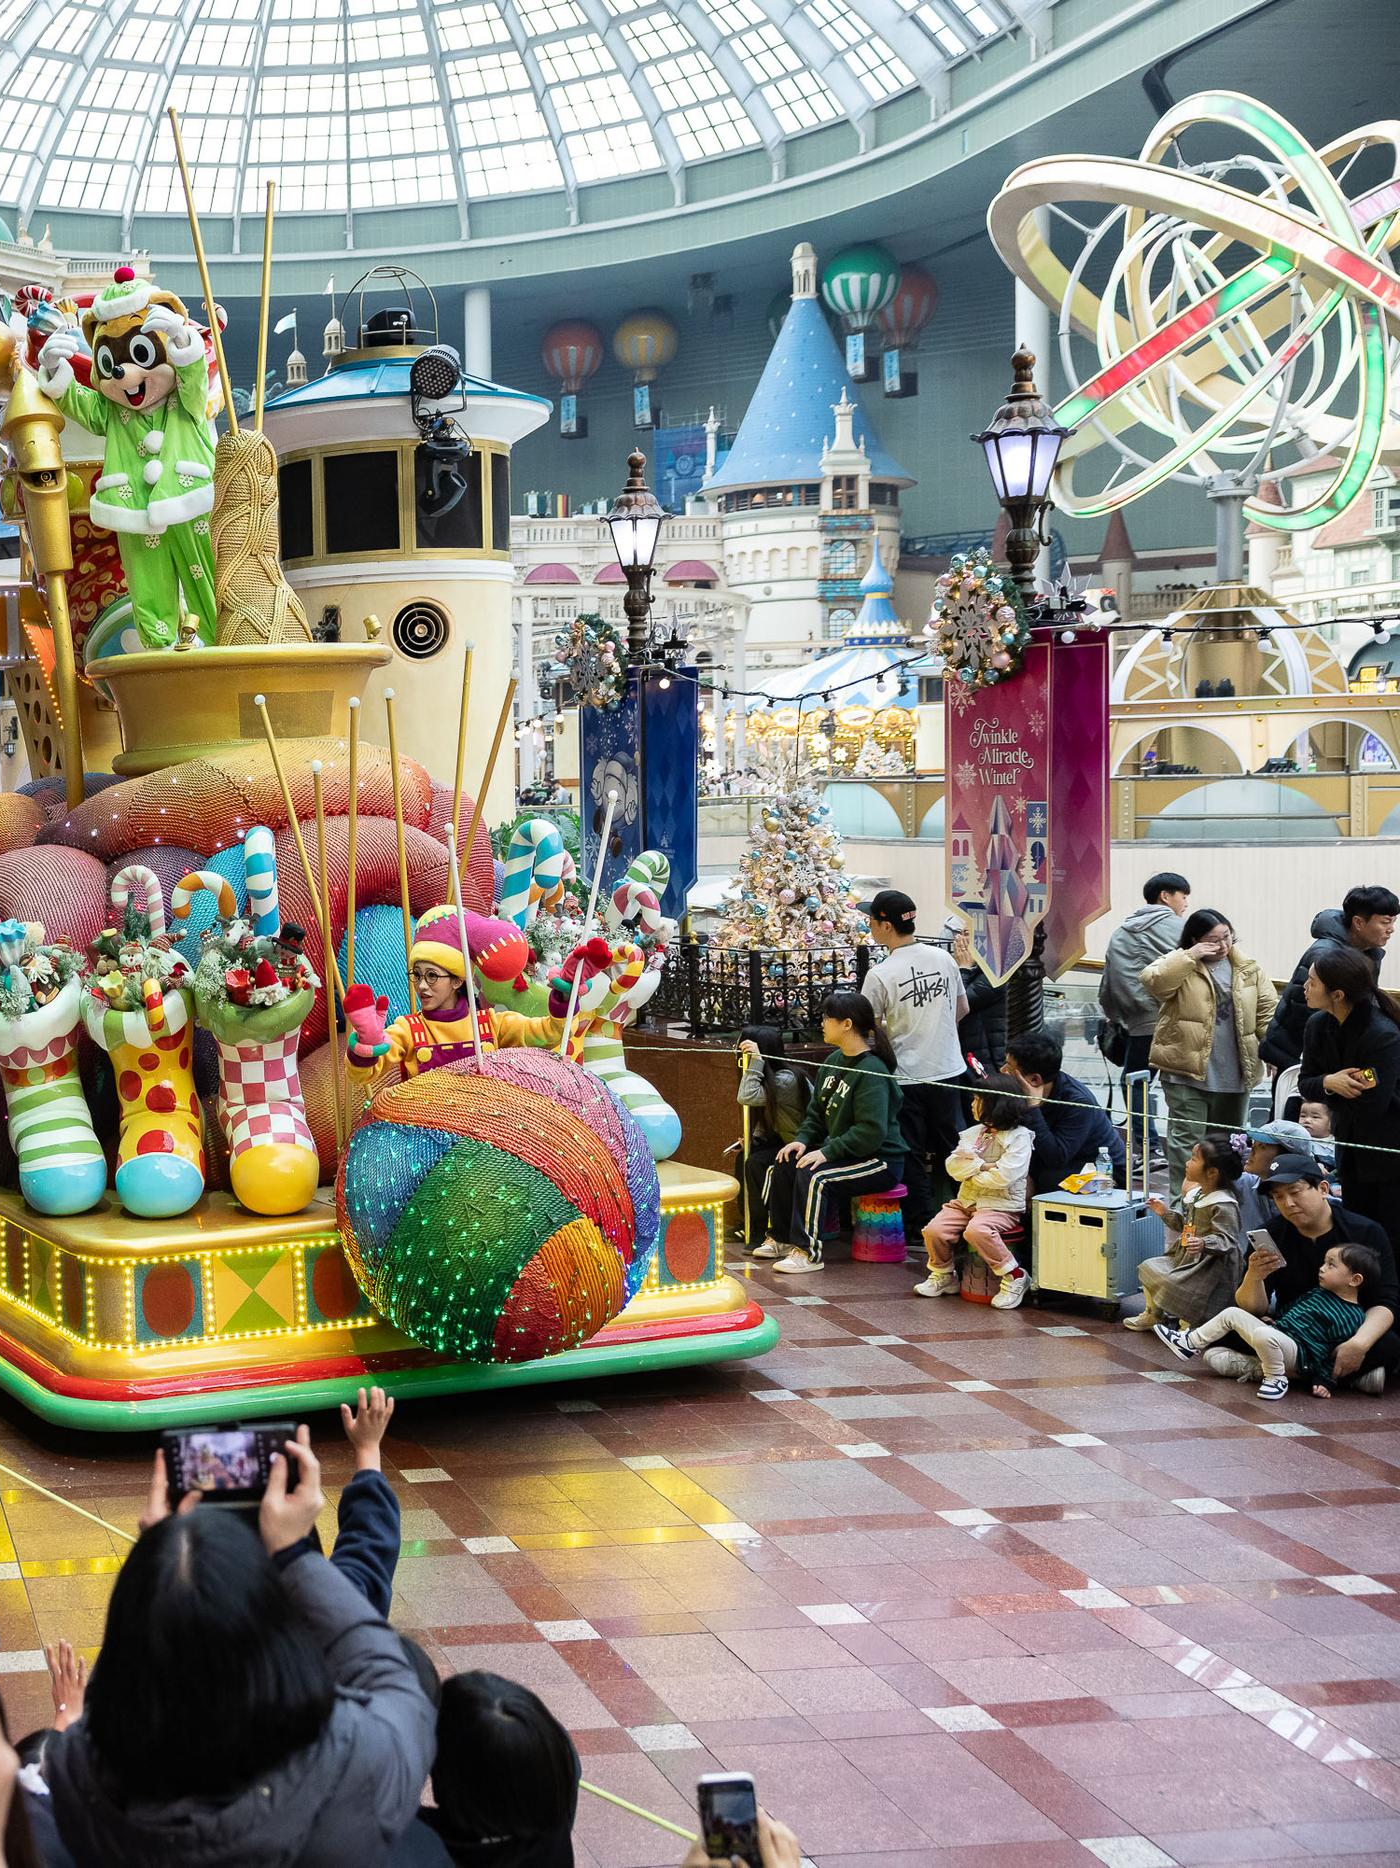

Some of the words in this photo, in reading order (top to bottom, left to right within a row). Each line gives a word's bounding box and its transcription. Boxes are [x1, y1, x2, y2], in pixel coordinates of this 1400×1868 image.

[970, 718, 1019, 749] Twinkle
[978, 747, 1035, 769] Miracle
[979, 768, 1021, 785] Winter
